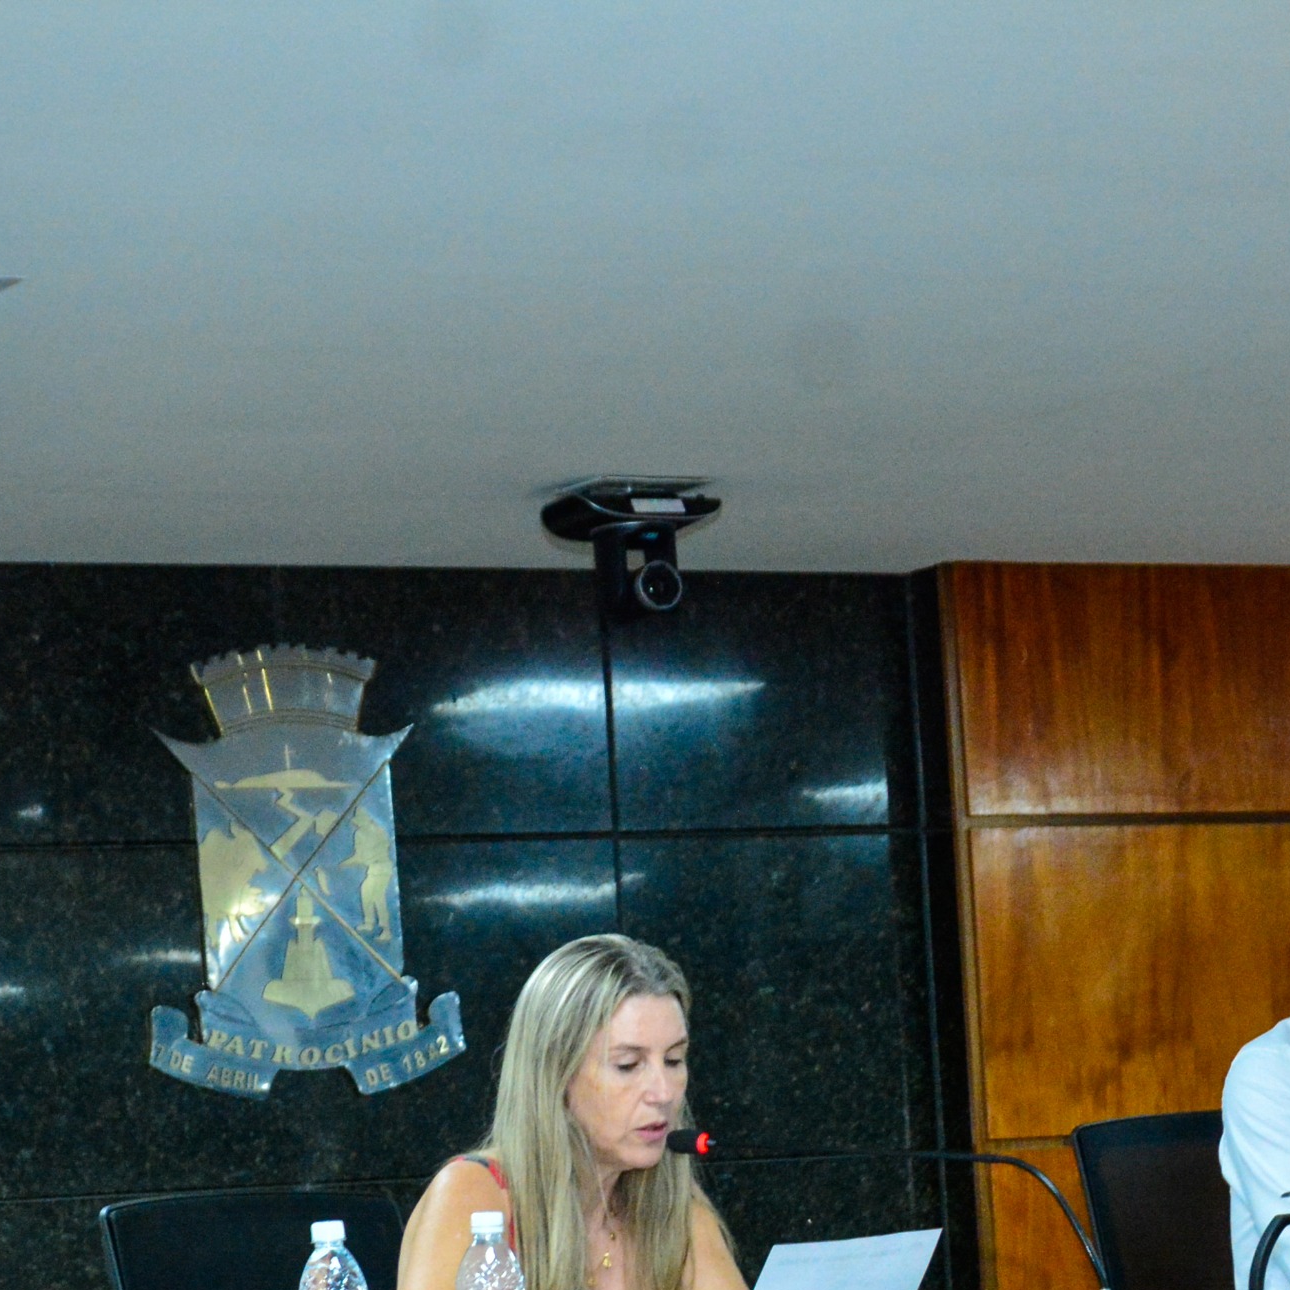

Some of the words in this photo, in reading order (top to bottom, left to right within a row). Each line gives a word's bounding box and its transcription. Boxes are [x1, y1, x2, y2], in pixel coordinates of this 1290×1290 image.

[170, 1050, 194, 1073] DE
[208, 1066, 261, 1091] ABRIL
[365, 1063, 391, 1087] DE
